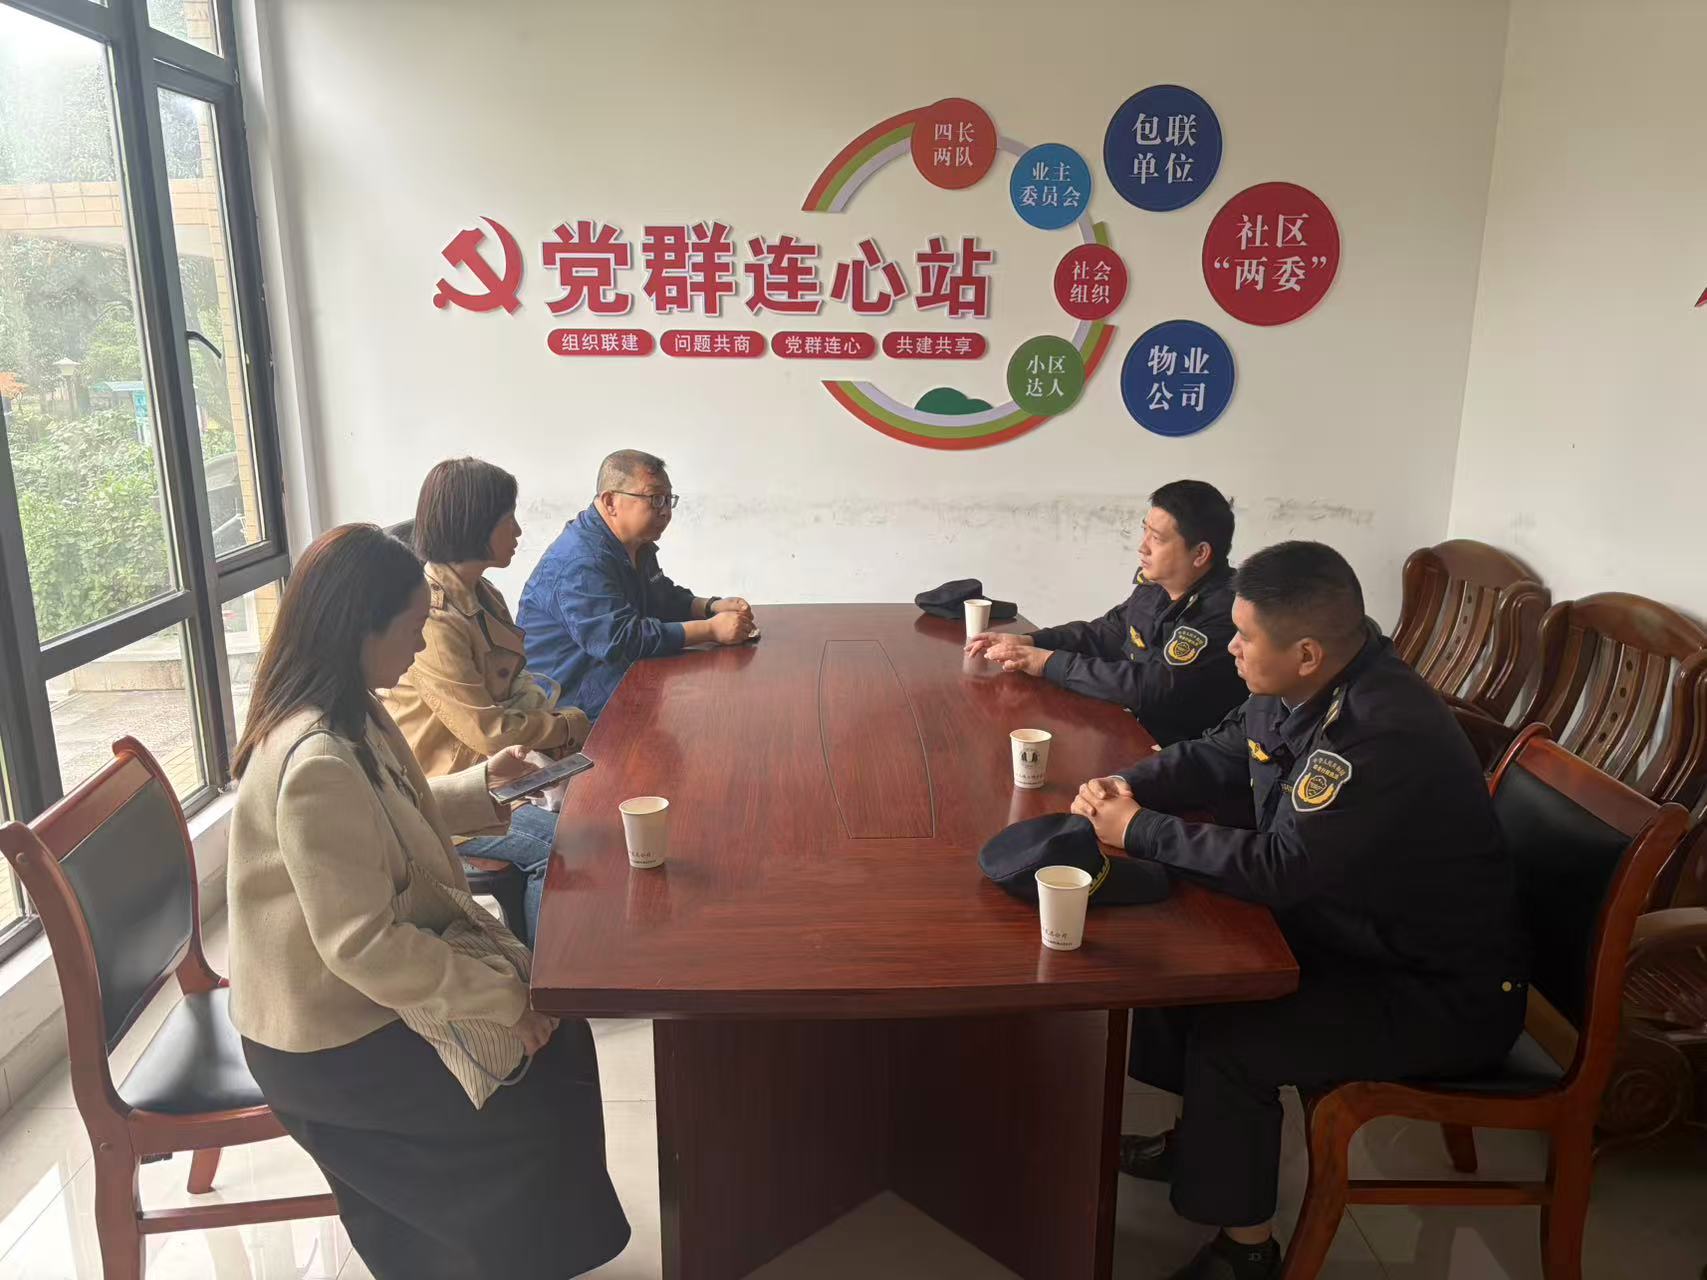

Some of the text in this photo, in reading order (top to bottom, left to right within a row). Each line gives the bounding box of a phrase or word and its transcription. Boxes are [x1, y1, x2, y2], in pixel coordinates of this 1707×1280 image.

[934, 121, 975, 142] 四长
[1132, 112, 1197, 147] 包联
[933, 146, 974, 167] 两队
[1032, 161, 1071, 182] 业主
[1130, 152, 1194, 185] 单位
[1020, 185, 1081, 207] 委员会
[1237, 213, 1309, 251] 社区
[542, 220, 993, 318] 党群连心站
[1072, 260, 1112, 281] 社会
[1213, 254, 1328, 293] “两委”
[1069, 283, 1110, 305] 组织
[561, 332, 639, 353] 组织联建
[674, 333, 751, 354] 问题共商
[785, 335, 862, 355] 党群连心
[896, 335, 973, 355] 共建共享
[1027, 354, 1066, 375] 小区
[1147, 344, 1210, 376] 物业
[1025, 377, 1065, 398] 达人
[1146, 381, 1206, 412] 公司
